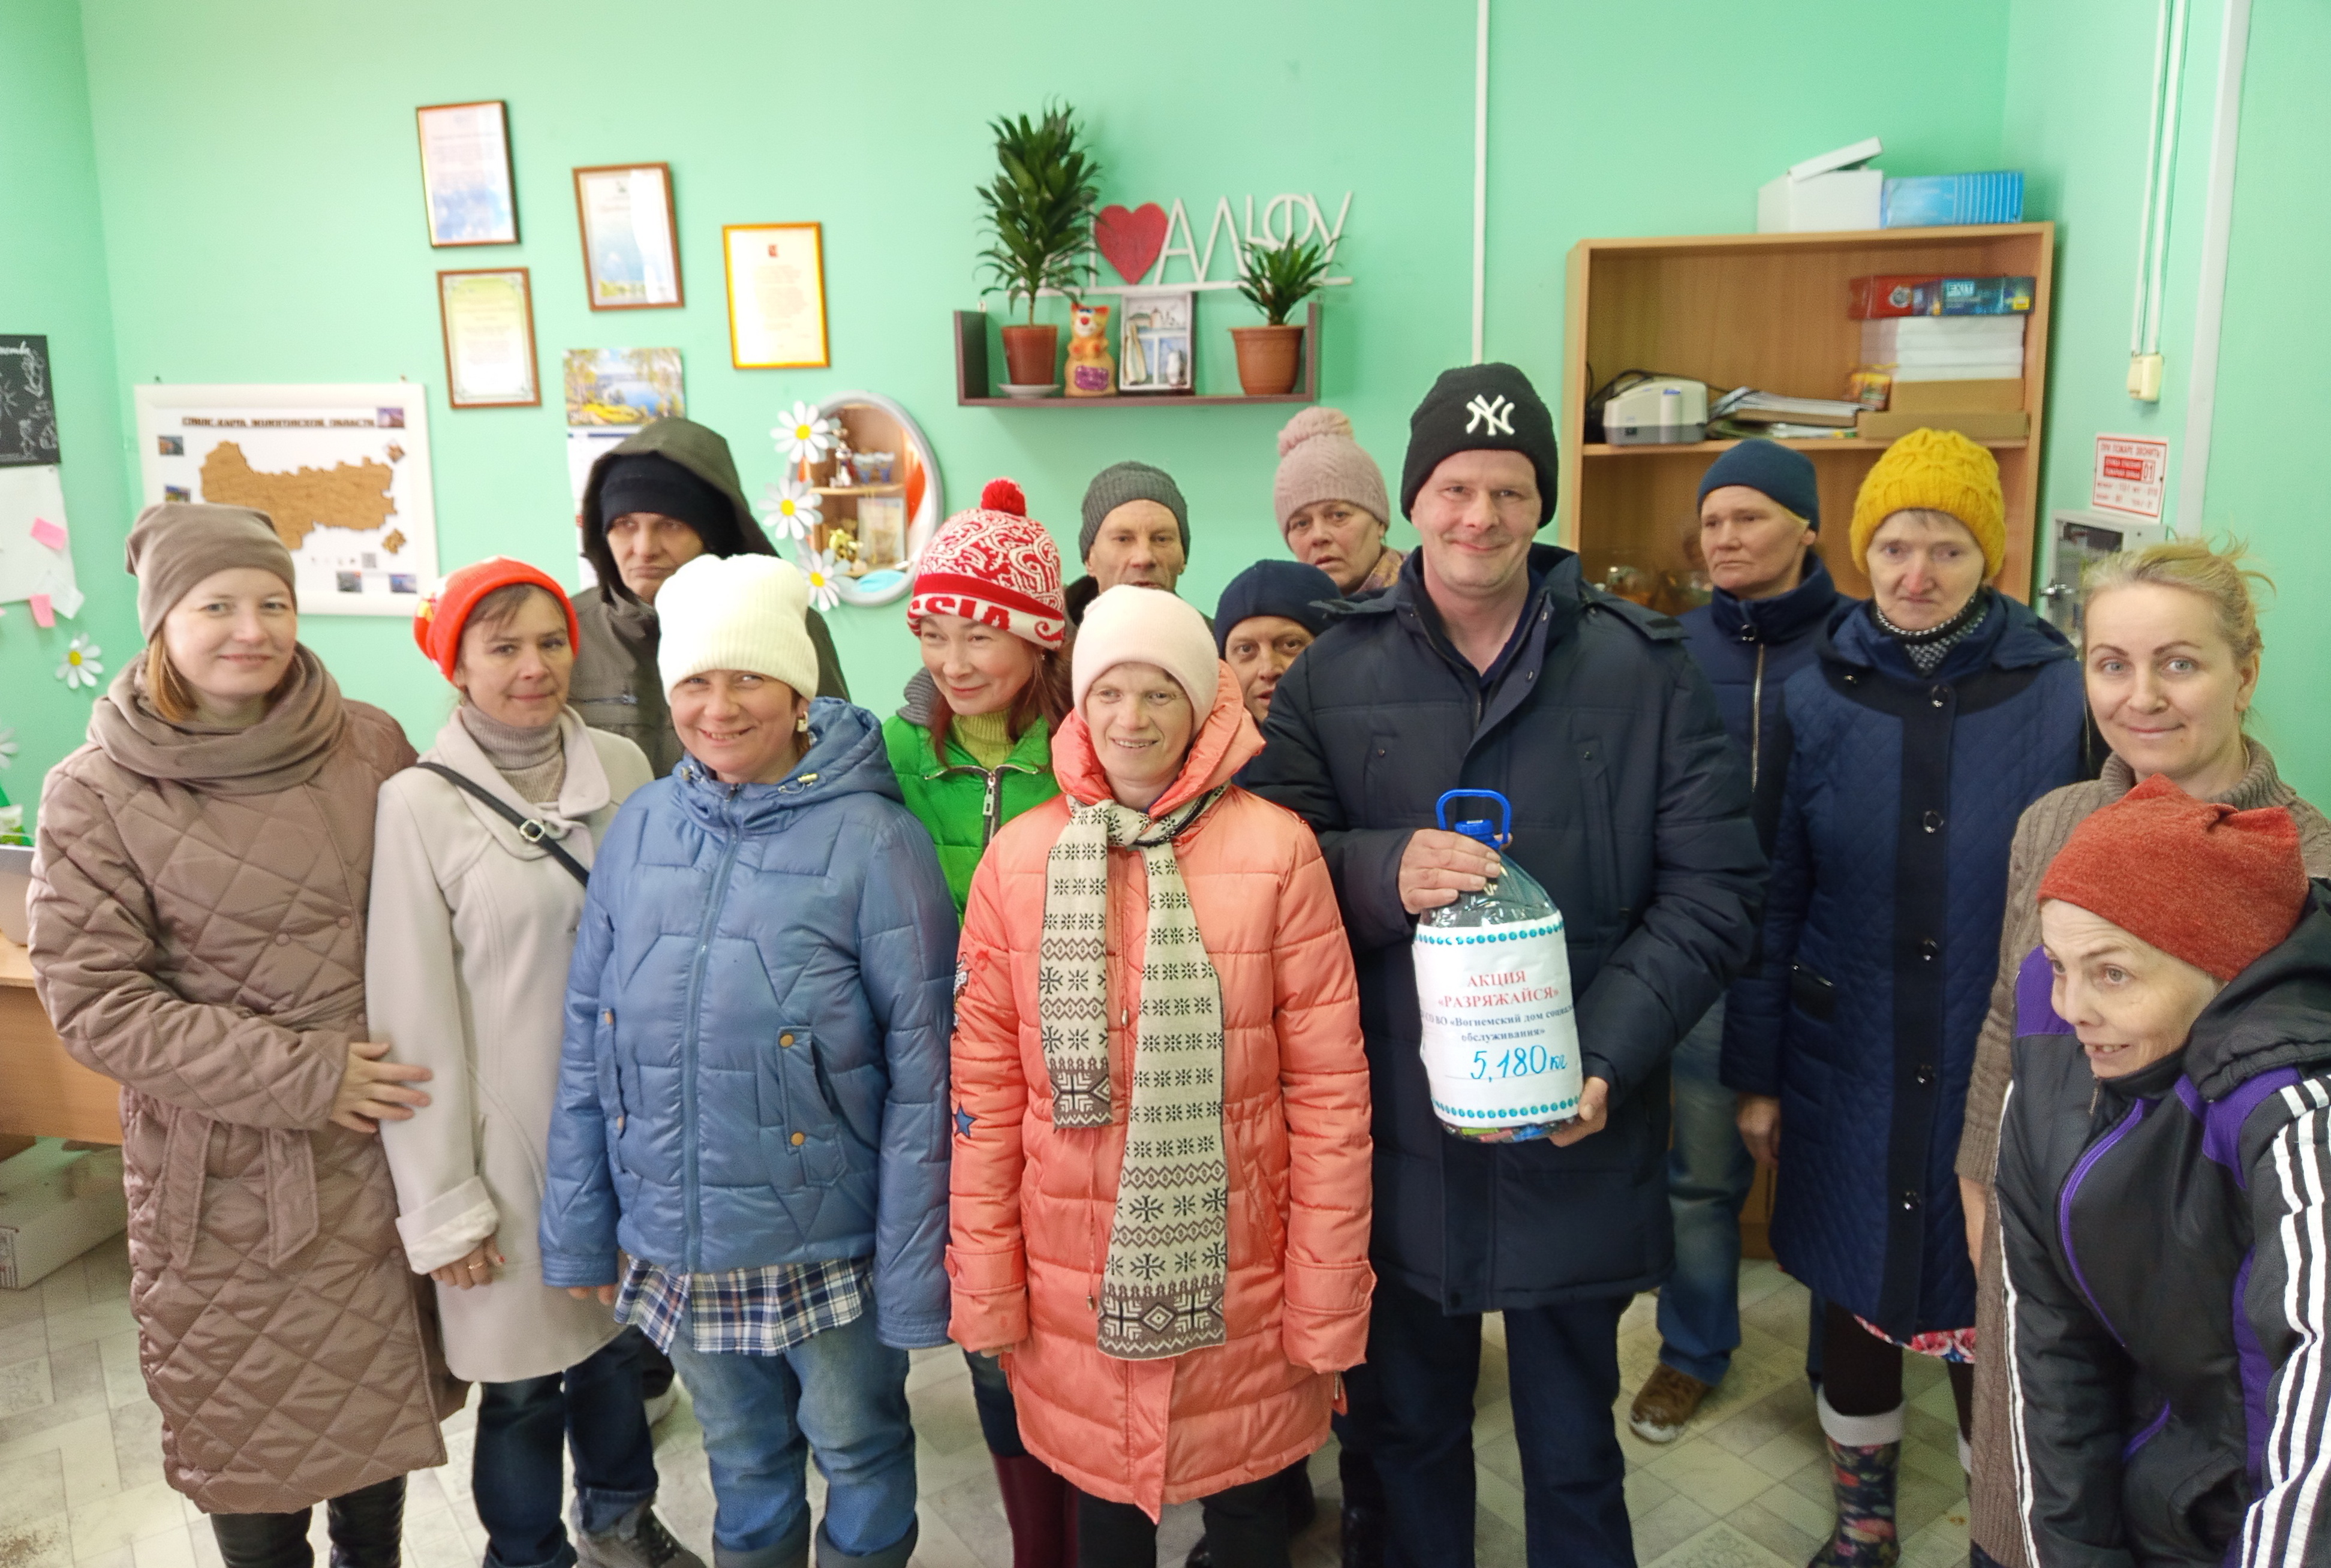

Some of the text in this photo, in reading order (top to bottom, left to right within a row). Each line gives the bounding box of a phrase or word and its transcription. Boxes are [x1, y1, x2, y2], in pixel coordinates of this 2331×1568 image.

[1466, 393, 1516, 437] NY
[1467, 970, 1527, 988] АКЦИЯ
[1438, 986, 1559, 1008] «РАЗРЯЖАЙСЯ»
[1524, 1012, 1544, 1022] дом
[1461, 1028, 1546, 1043] обслуживания»
[1470, 1045, 1547, 1082] 5,180
